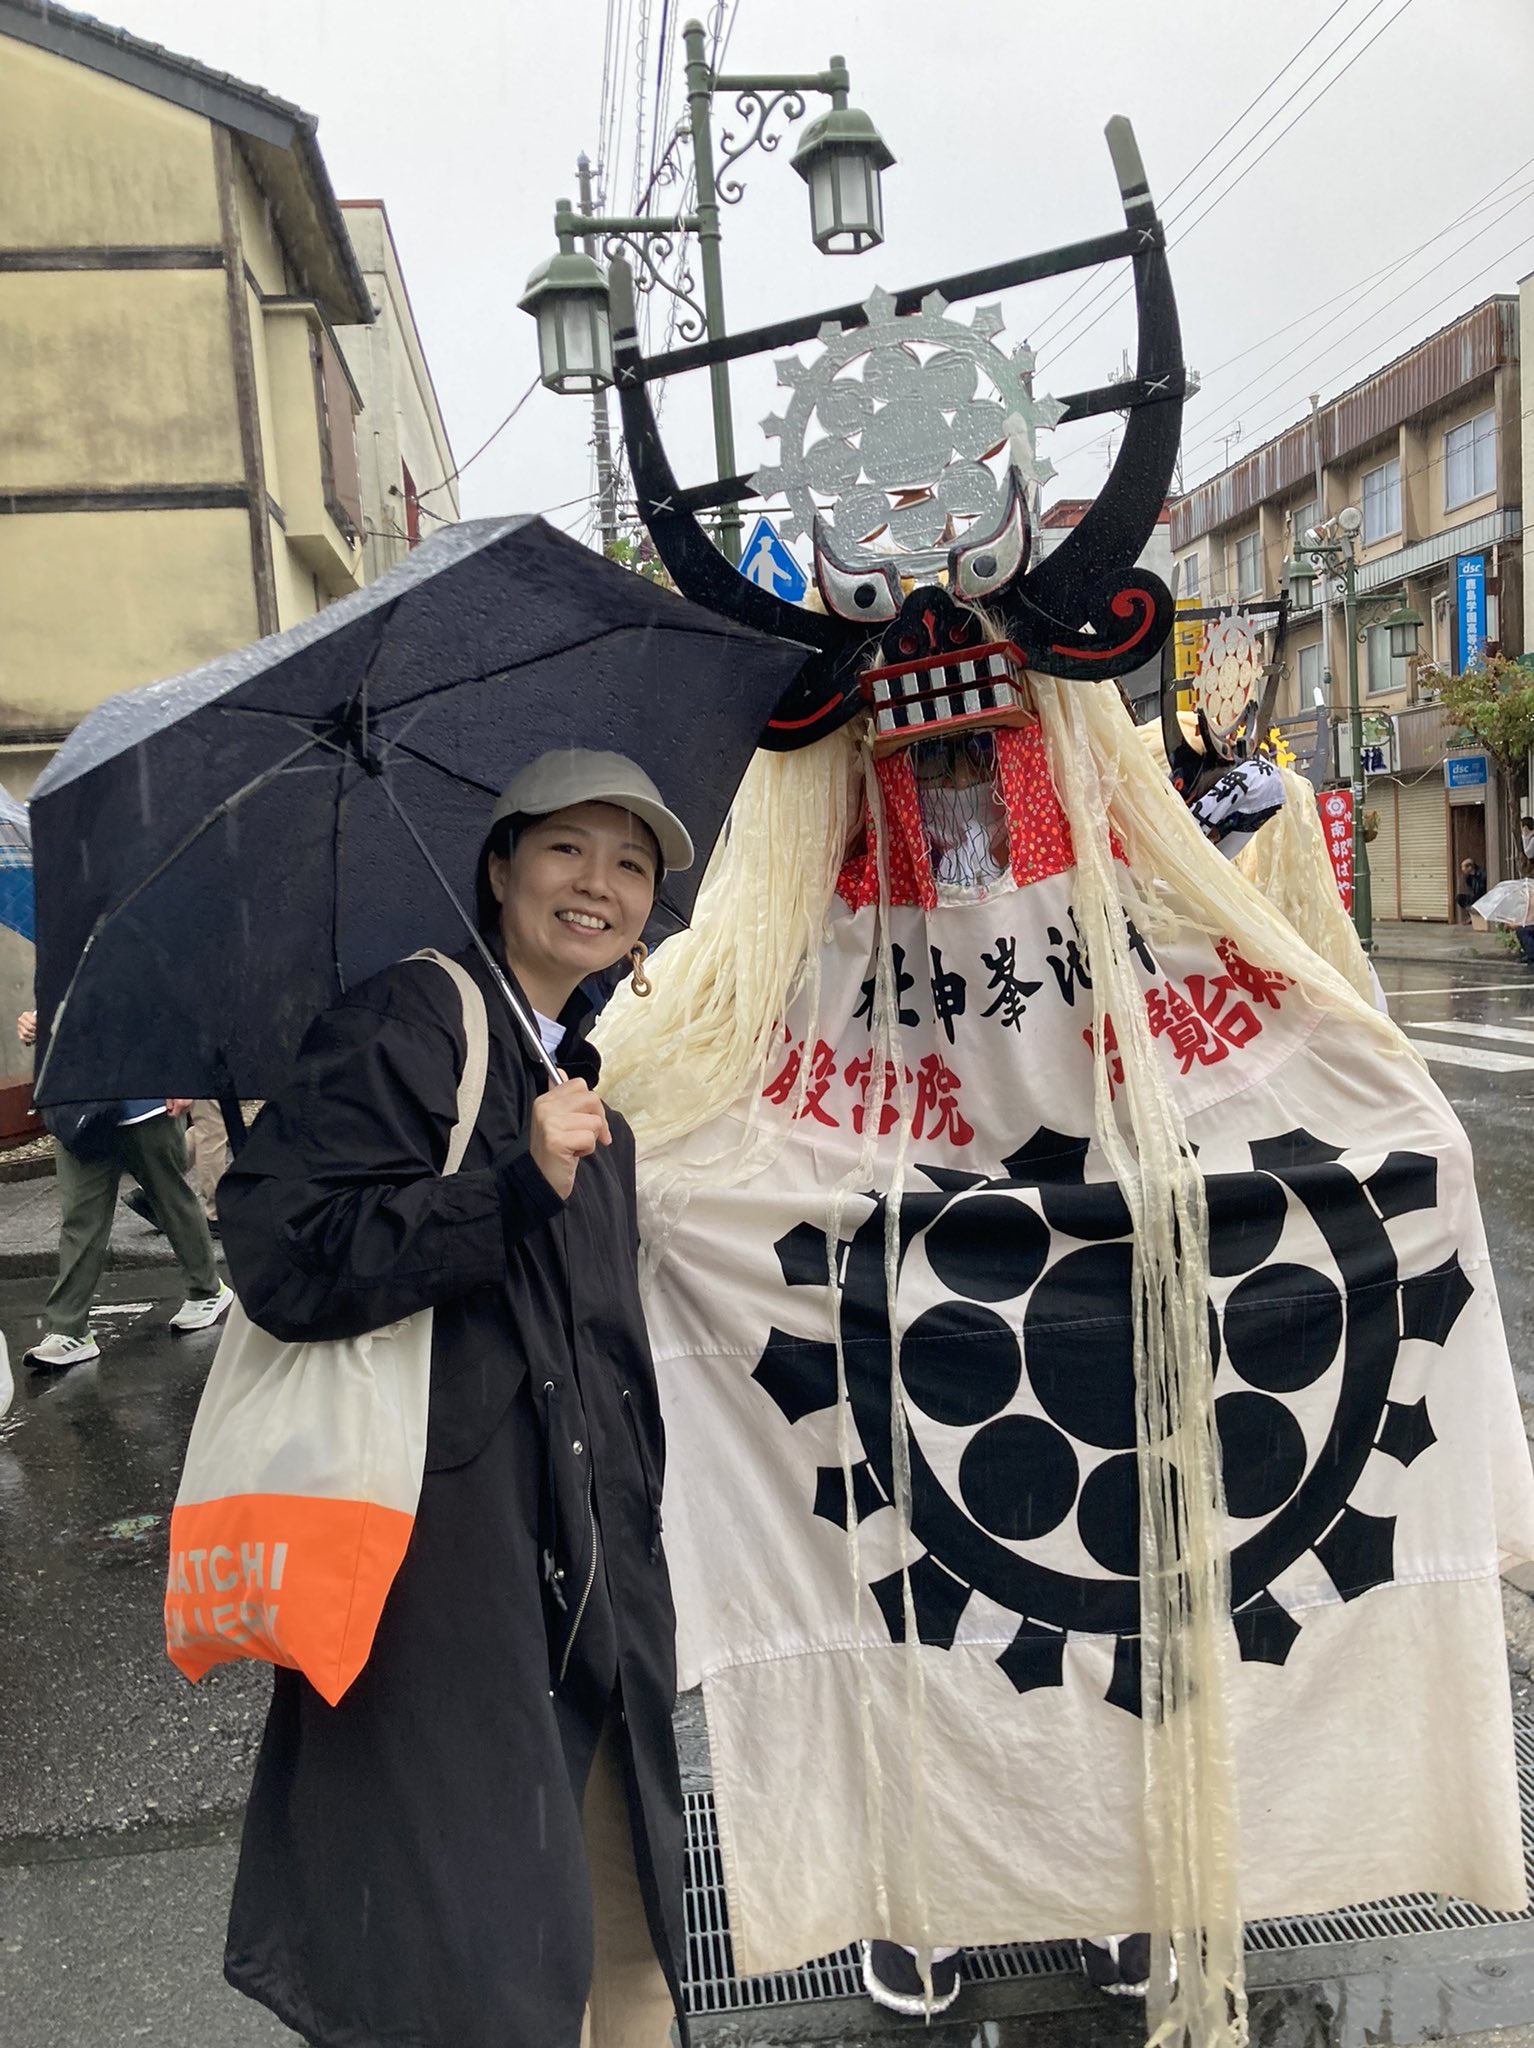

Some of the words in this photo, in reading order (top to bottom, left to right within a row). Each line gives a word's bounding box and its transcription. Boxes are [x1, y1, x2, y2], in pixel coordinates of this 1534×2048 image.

[1462, 562, 1481, 574] dsc
[1452, 764, 1470, 774] dsc
[1330, 820, 1351, 914] 南部ばや
